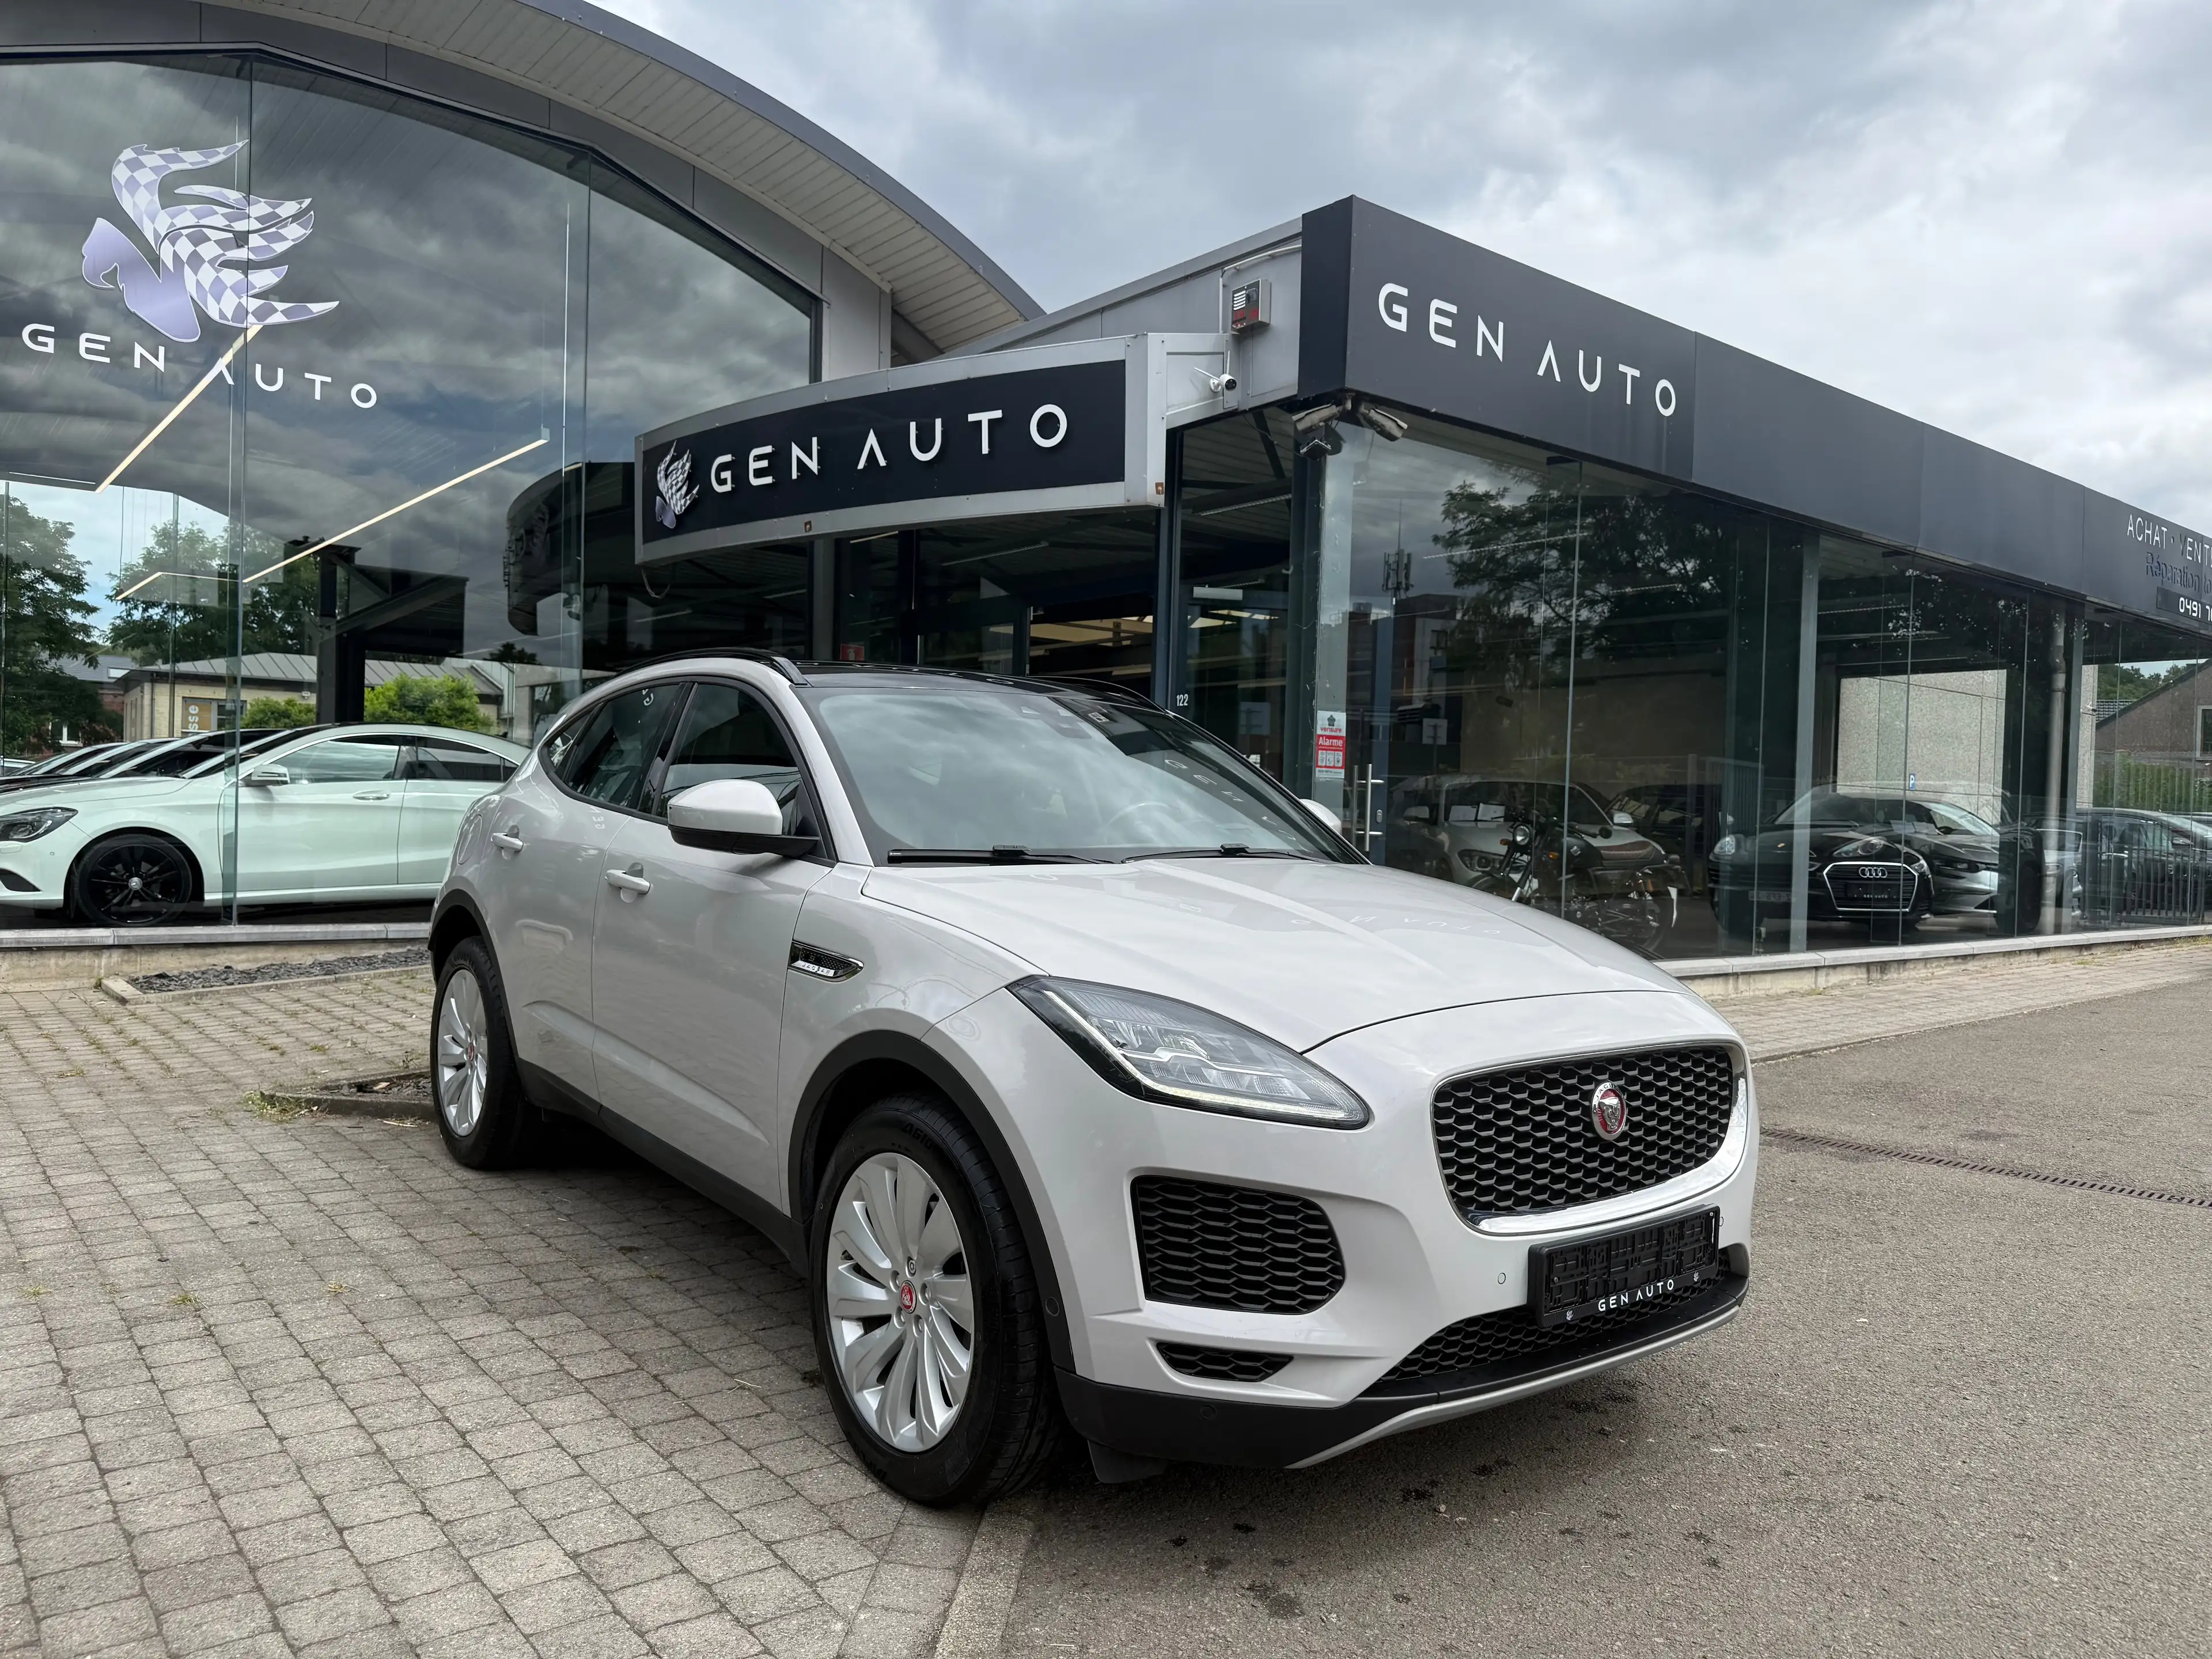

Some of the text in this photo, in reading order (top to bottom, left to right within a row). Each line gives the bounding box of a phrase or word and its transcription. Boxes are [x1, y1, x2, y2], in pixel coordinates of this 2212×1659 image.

[21, 323, 377, 409] GEN AUTO
[1378, 282, 1676, 417] GEN AUTO
[710, 404, 1068, 494] GEN AUTO
[2127, 514, 2168, 550] ACHAT
[2146, 551, 2200, 593] Réparation
[2179, 597, 2201, 618] 0491
[1176, 694, 1188, 706] 122
[1319, 736, 1343, 747] Alarme
[1910, 774, 1915, 788] P
[1598, 1279, 1674, 1312] GEN AUTO
